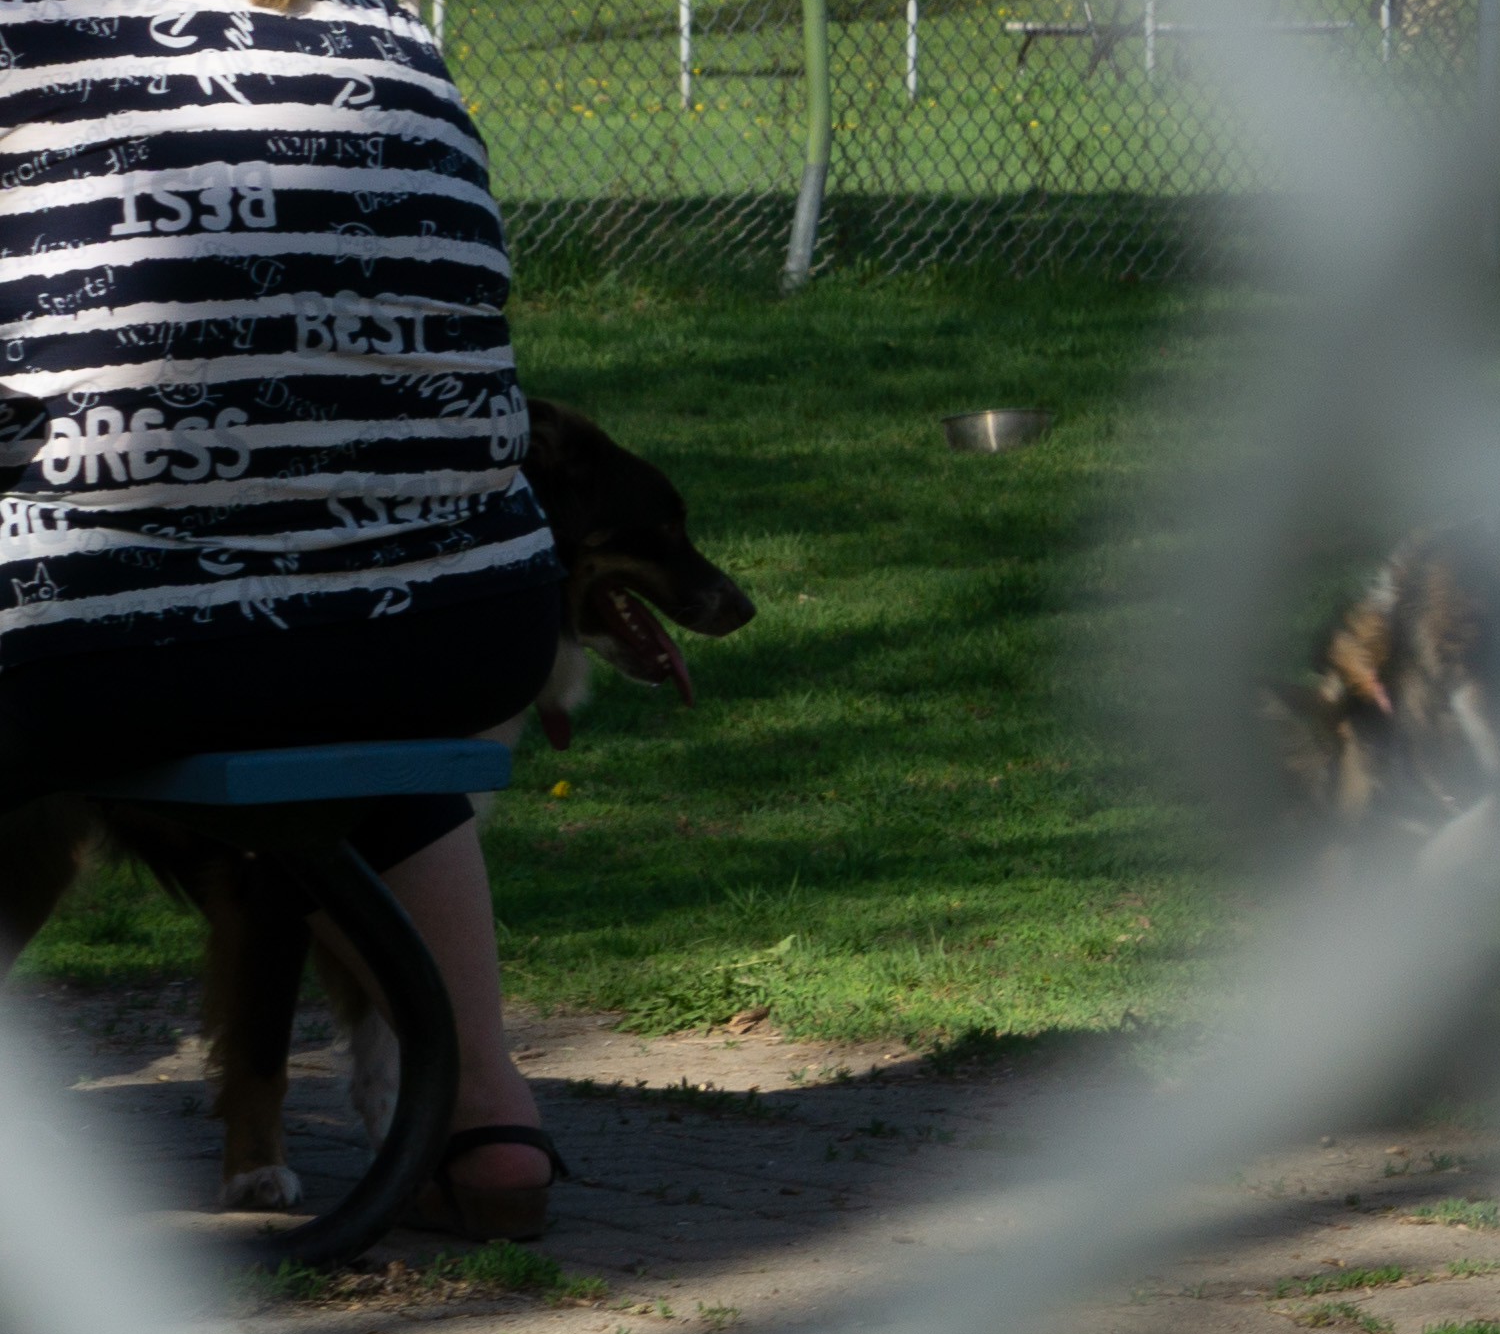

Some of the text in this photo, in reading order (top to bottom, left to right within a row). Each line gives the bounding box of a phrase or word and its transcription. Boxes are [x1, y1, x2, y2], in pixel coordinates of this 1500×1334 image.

[110, 160, 277, 236] BEST
[295, 290, 433, 359] BEST
[43, 406, 250, 486] DRESS
